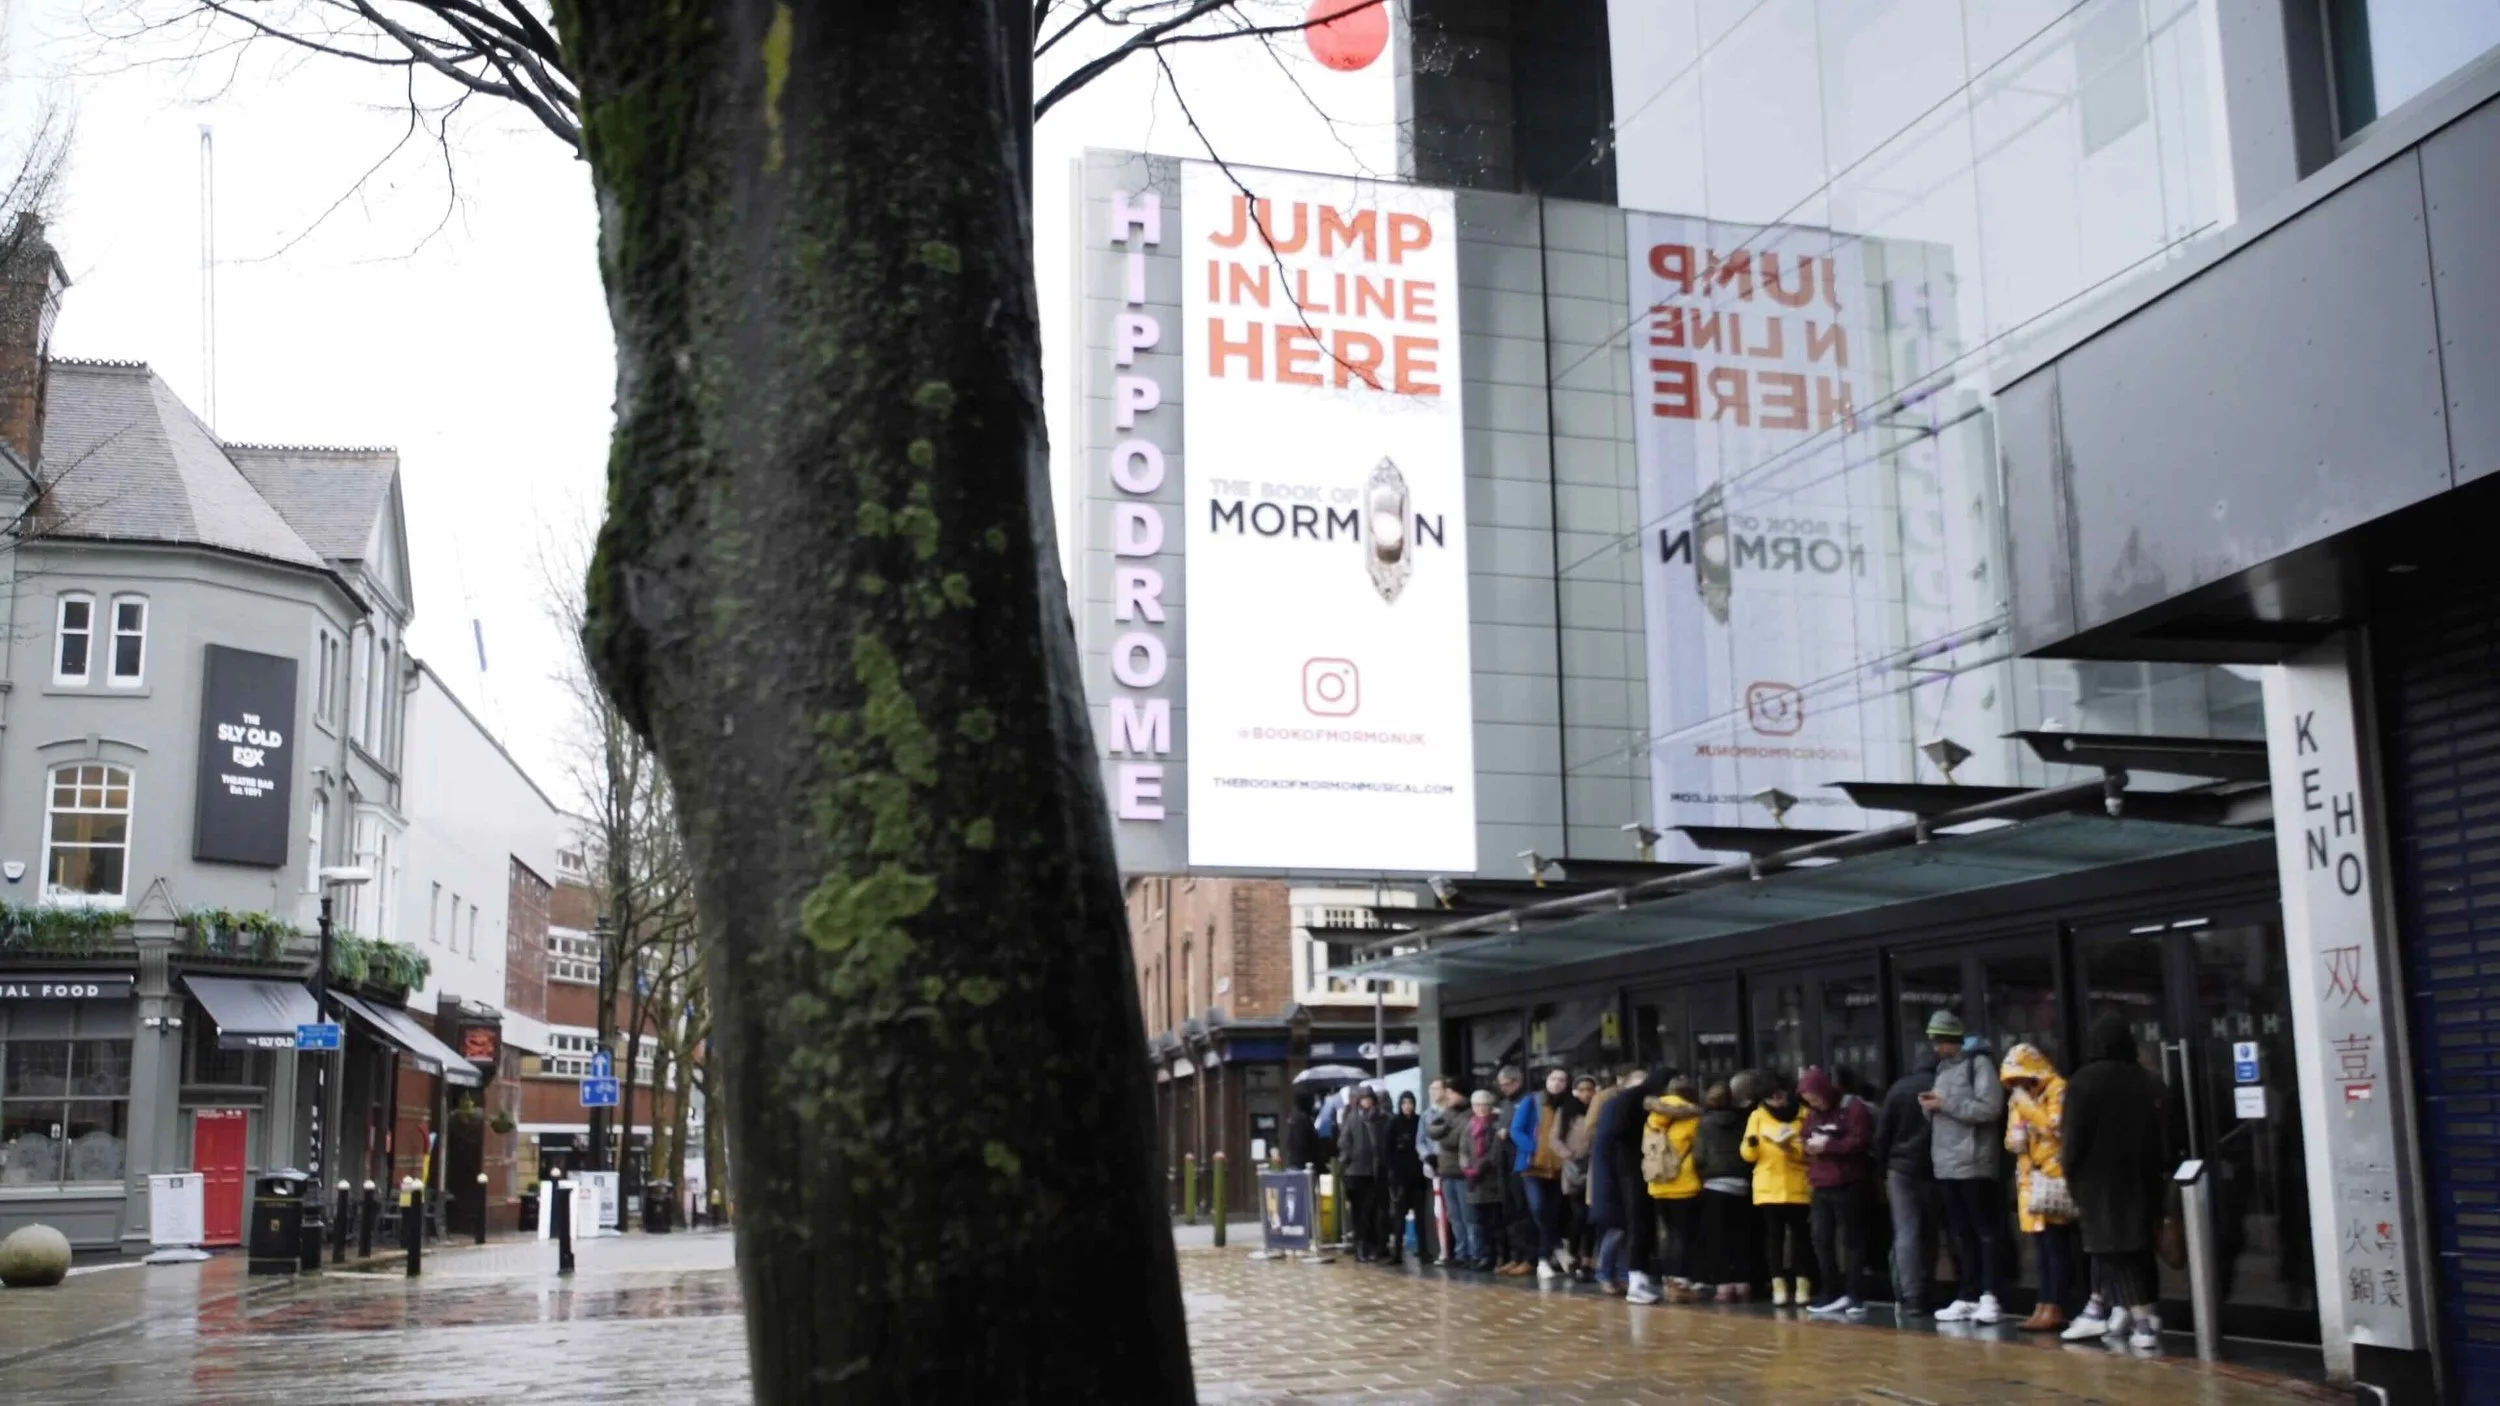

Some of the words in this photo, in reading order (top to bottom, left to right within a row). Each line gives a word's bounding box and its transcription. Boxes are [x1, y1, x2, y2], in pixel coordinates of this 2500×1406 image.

[1208, 194, 1433, 265] JUMP
[1208, 259, 1270, 309] IN
[1297, 267, 1438, 325] LINE
[1208, 317, 1441, 398] HERE
[1209, 478, 1252, 498] THE
[1261, 480, 1323, 502] BOOK
[1330, 483, 1360, 505] OF
[1109, 190, 1171, 822] HIPPODROME
[242, 712, 260, 725] THE
[218, 722, 246, 743] SLY
[247, 728, 282, 748] OLD
[232, 746, 265, 768] FOX
[42, 984, 99, 998] FOOD
[258, 1036, 274, 1048] SLY
[275, 1036, 296, 1048] OLD
